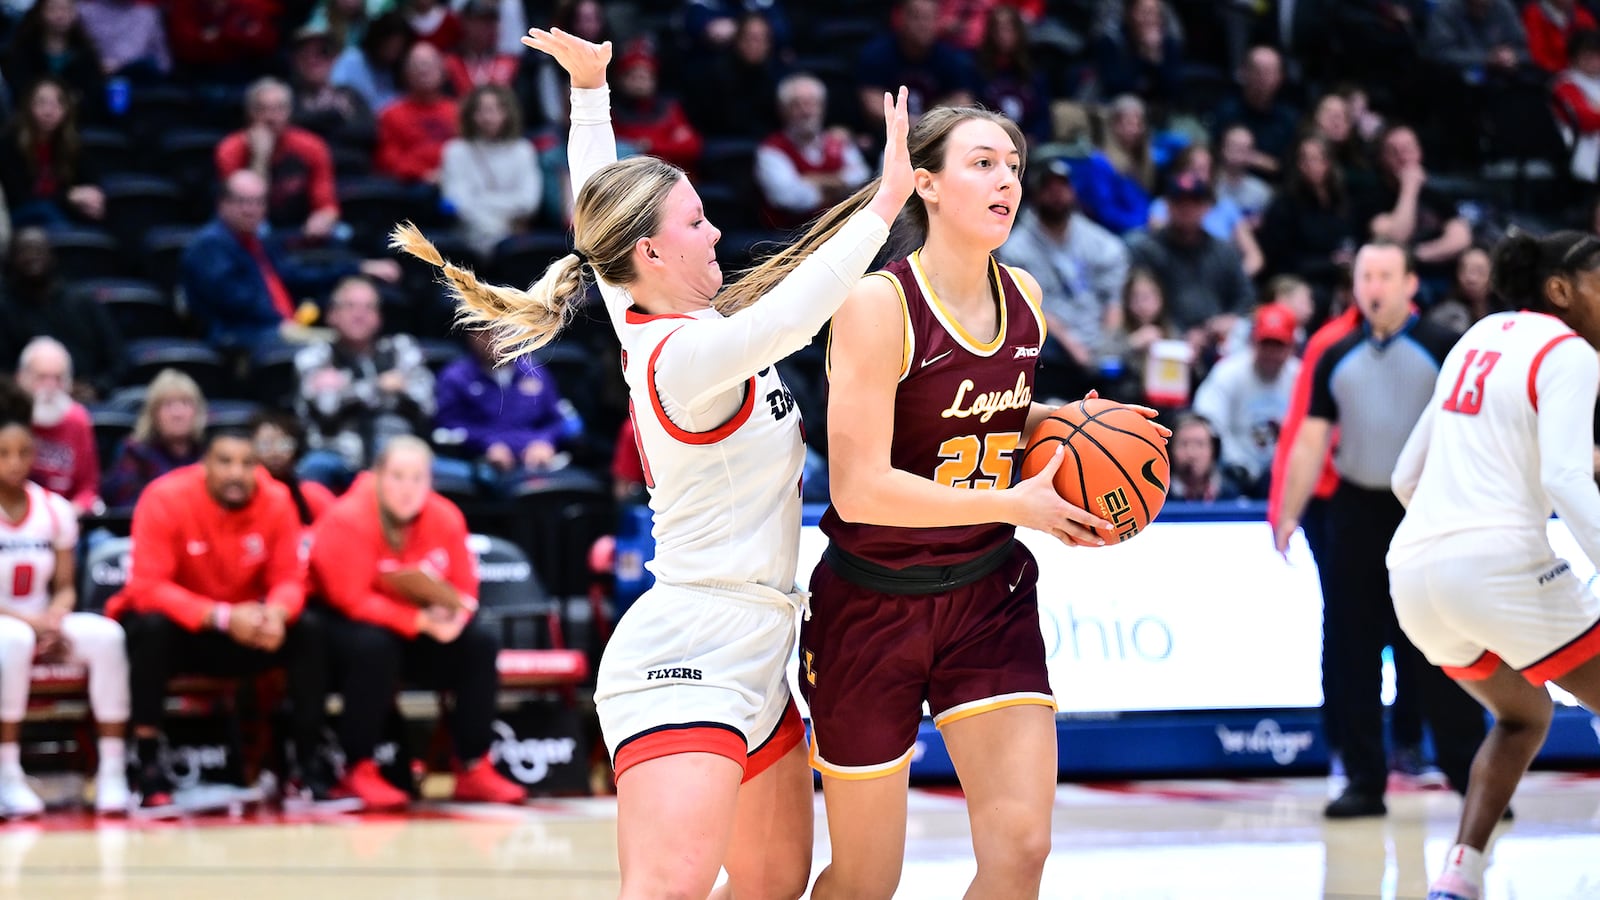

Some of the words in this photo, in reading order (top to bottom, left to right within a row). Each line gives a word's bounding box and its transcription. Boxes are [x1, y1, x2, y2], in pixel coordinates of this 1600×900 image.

[941, 370, 1032, 424] Loyola
[1442, 349, 1502, 416] 13
[933, 431, 1022, 490] 25
[13, 562, 34, 597] 0
[646, 667, 703, 681] FLYERS
